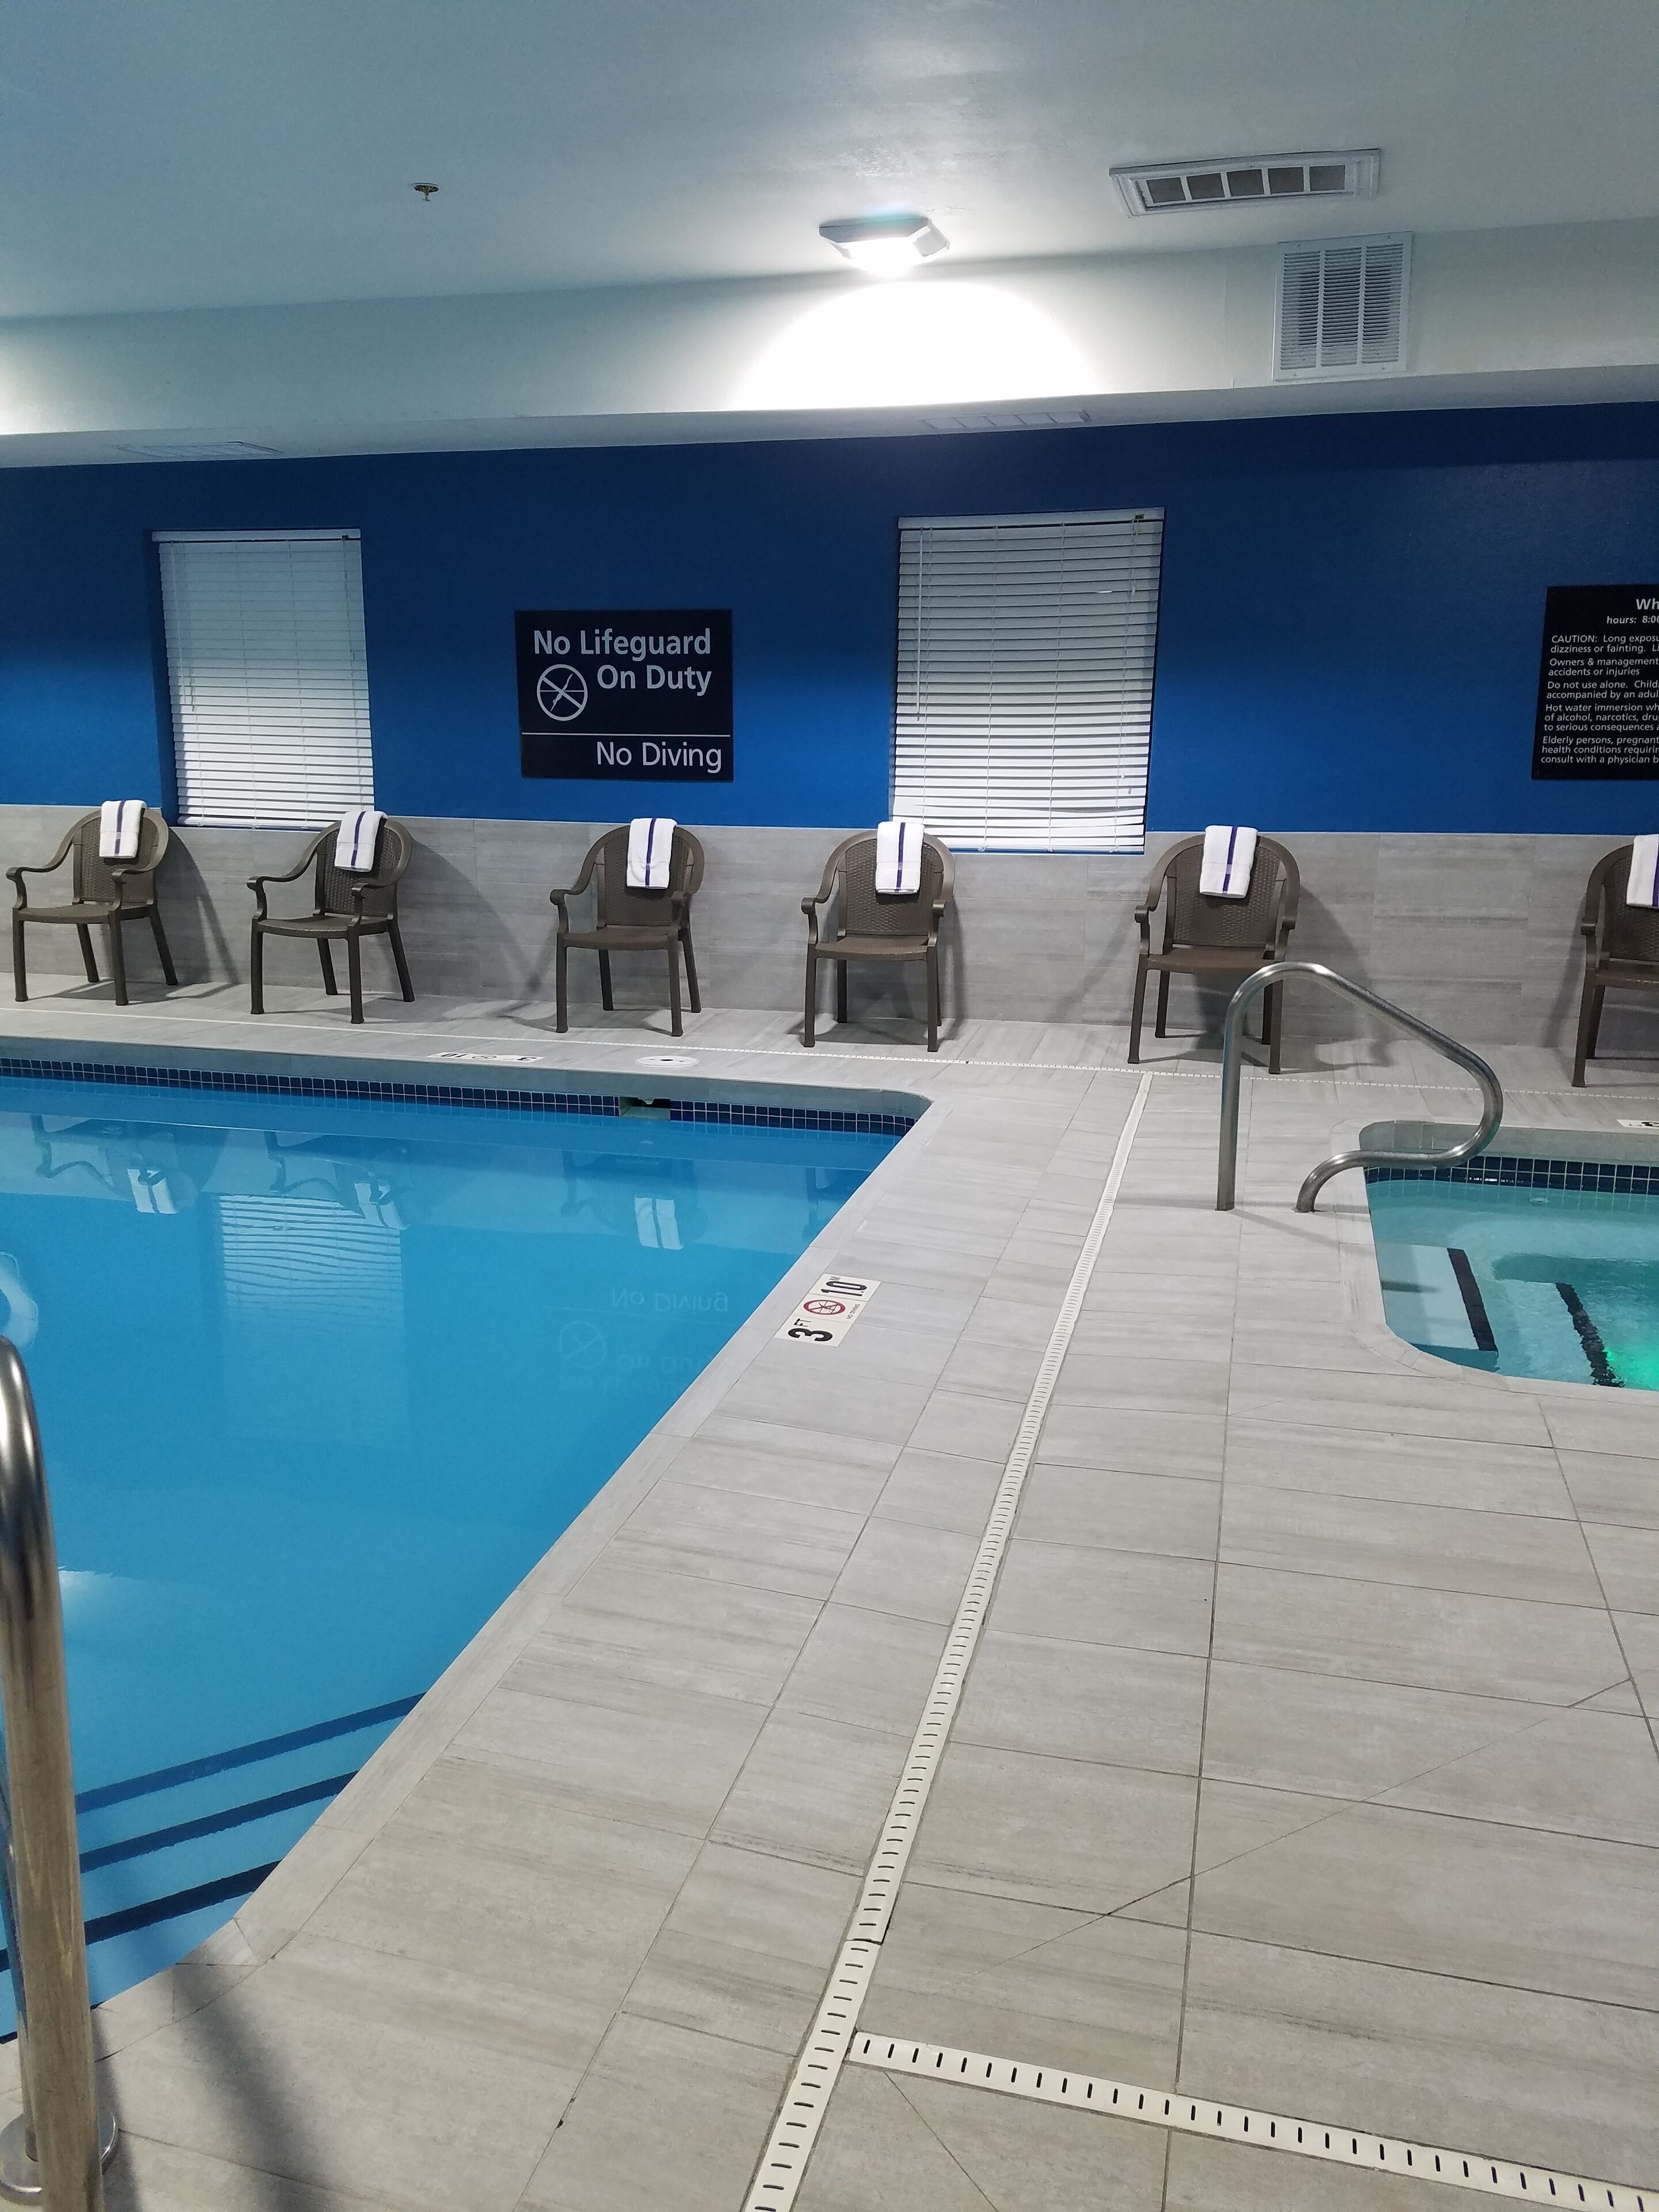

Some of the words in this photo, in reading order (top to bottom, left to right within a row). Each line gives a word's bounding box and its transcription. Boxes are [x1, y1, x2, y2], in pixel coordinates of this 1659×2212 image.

[1607, 615, 1637, 624] hours:
[1551, 635, 1597, 643] CAUTION:
[1603, 635, 1626, 644] Long
[535, 630, 570, 654] No
[581, 628, 711, 661] Lifeguard
[1550, 645, 1591, 653] dizziness
[1607, 644, 1646, 654] fainting.
[1597, 658, 1659, 667] management
[1548, 668, 1590, 676] accidents
[1606, 667, 1640, 677] injuries
[597, 664, 636, 689] On
[646, 665, 712, 696] Duty
[1600, 680, 1628, 688] alone.
[1634, 680, 1659, 688] Child
[1547, 690, 1607, 700] accompanied
[1610, 690, 1621, 700] by
[1594, 703, 1643, 711] immersion
[1544, 713, 1555, 721] of
[1557, 713, 1592, 722] alcohol,
[1596, 713, 1639, 722] narcotics,
[1642, 713, 1659, 722] dru
[1556, 722, 1588, 731] serious
[1590, 724, 1654, 733] consequences
[1543, 736, 1574, 745] Elderly
[1576, 737, 1613, 745] persons,
[1542, 745, 1571, 753] health
[1574, 745, 1622, 753] conditions
[597, 741, 632, 766] No
[642, 741, 722, 774] Diving
[1541, 755, 1574, 763] consult
[1576, 755, 1596, 763] with
[1608, 755, 1650, 765] physician
[794, 1318, 811, 1327] FT
[788, 1328, 833, 1342] 3
